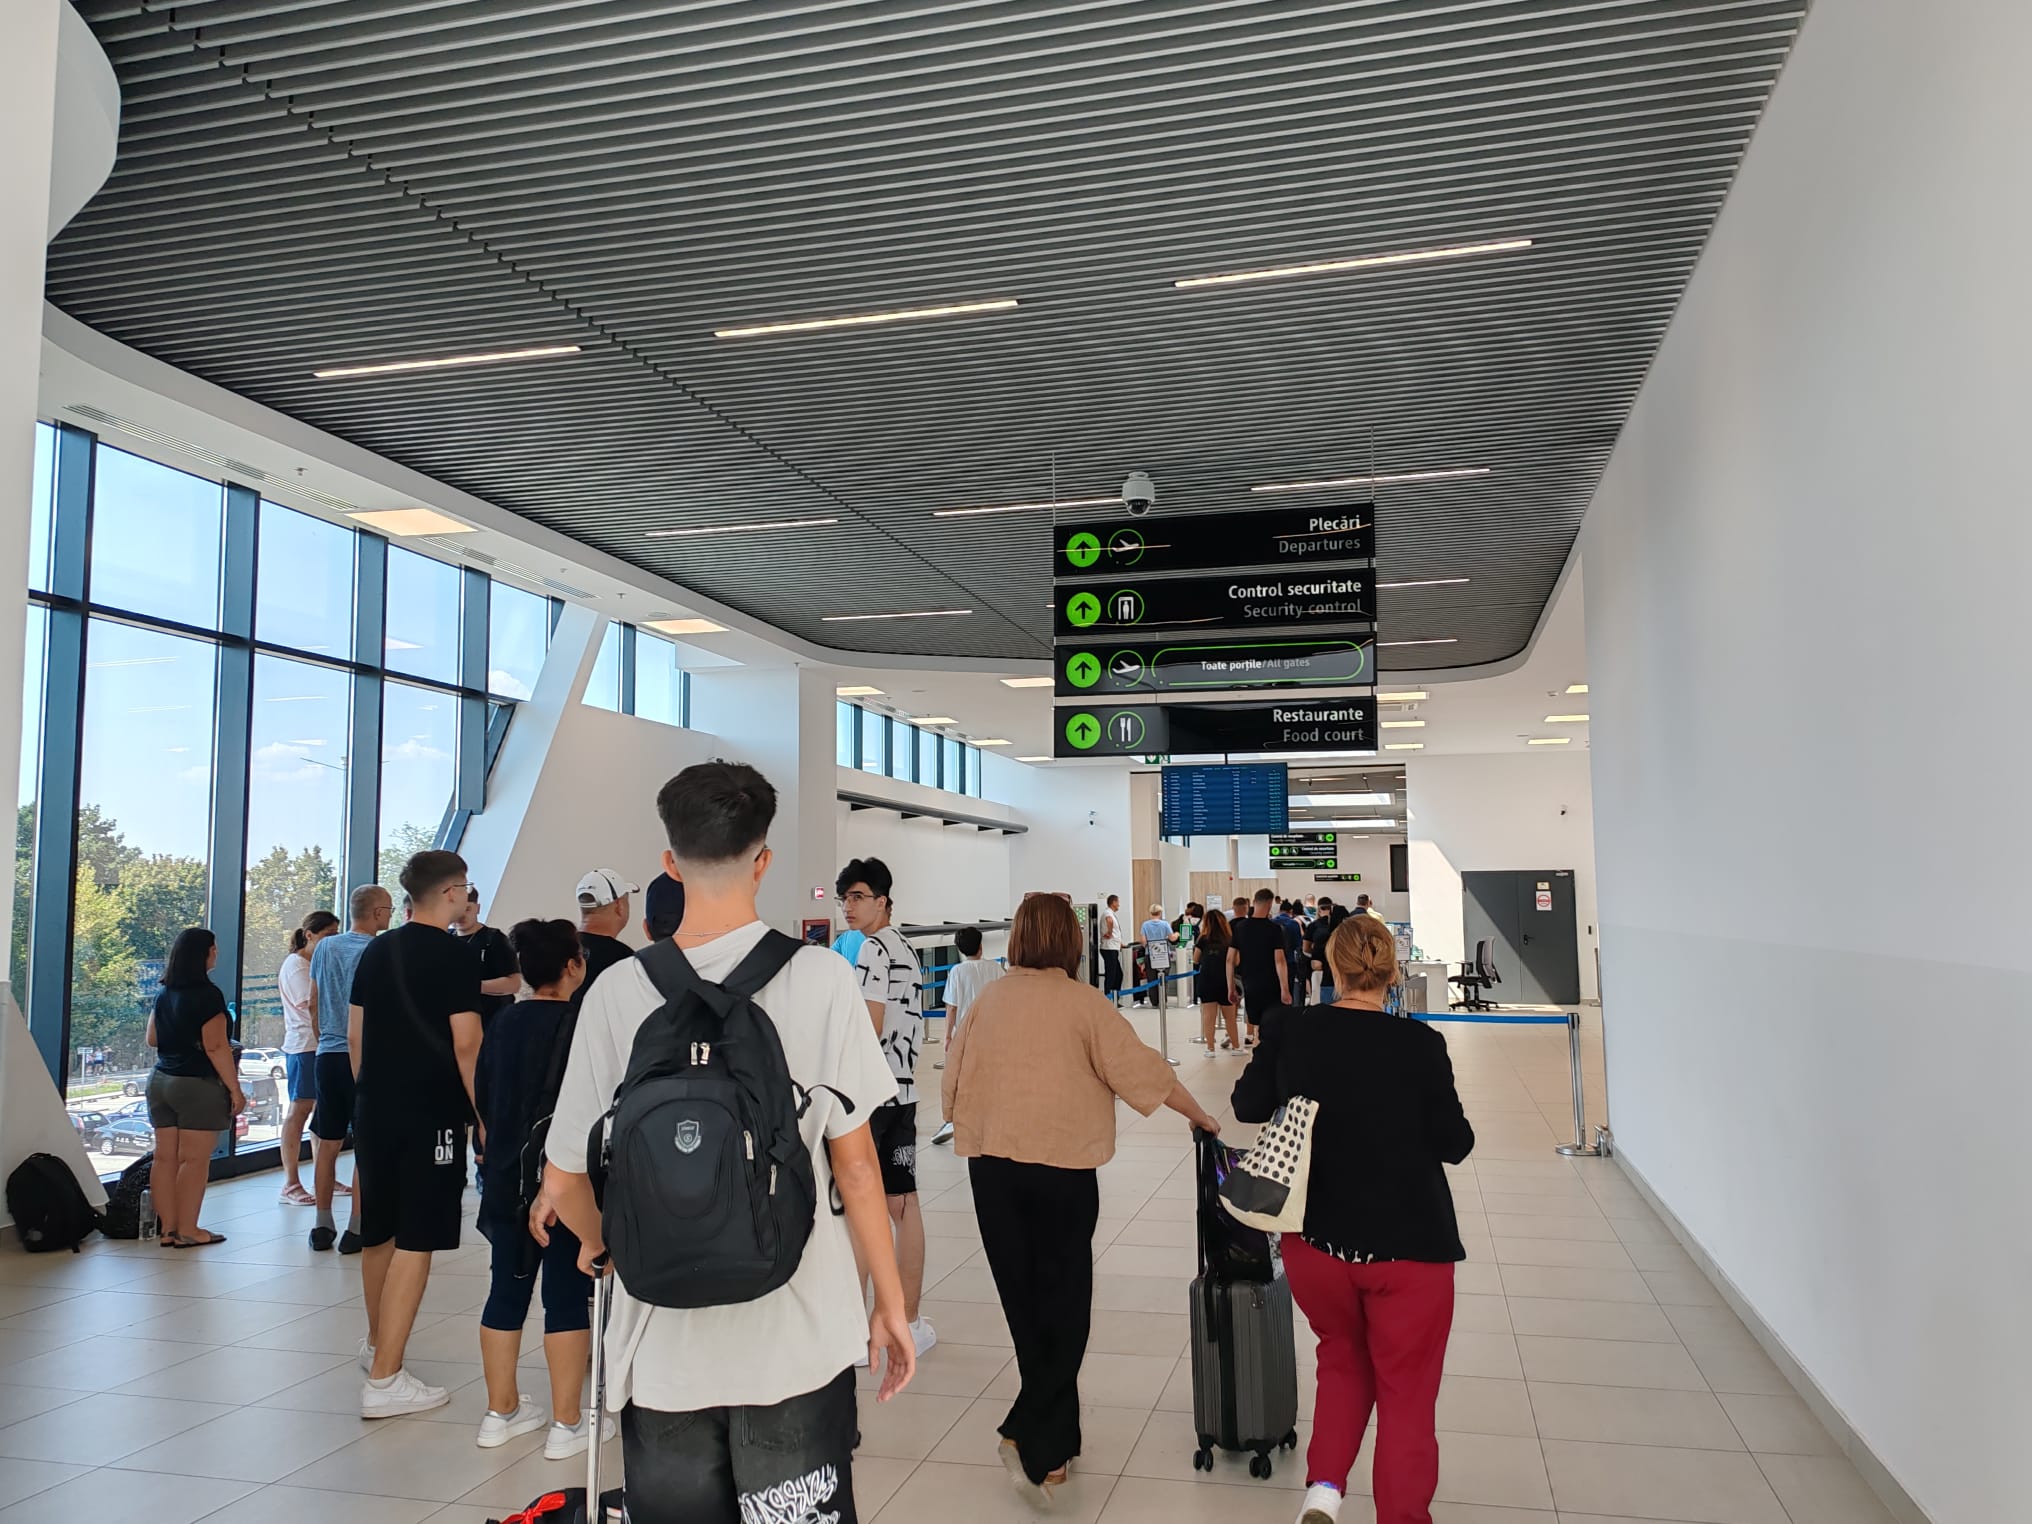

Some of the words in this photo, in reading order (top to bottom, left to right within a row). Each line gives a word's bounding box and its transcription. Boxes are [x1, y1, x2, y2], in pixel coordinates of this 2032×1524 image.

[1309, 514, 1361, 532] Plecări
[1279, 538, 1361, 556] Departures
[1228, 582, 1283, 599] Control
[1287, 579, 1362, 596] securitate
[1243, 602, 1303, 619] Security
[1308, 598, 1361, 614] control
[1201, 660, 1227, 671] Toate
[1283, 658, 1311, 669] gates
[1273, 707, 1364, 723] Restaurante
[1283, 727, 1319, 743] Food
[1324, 728, 1364, 742] court
